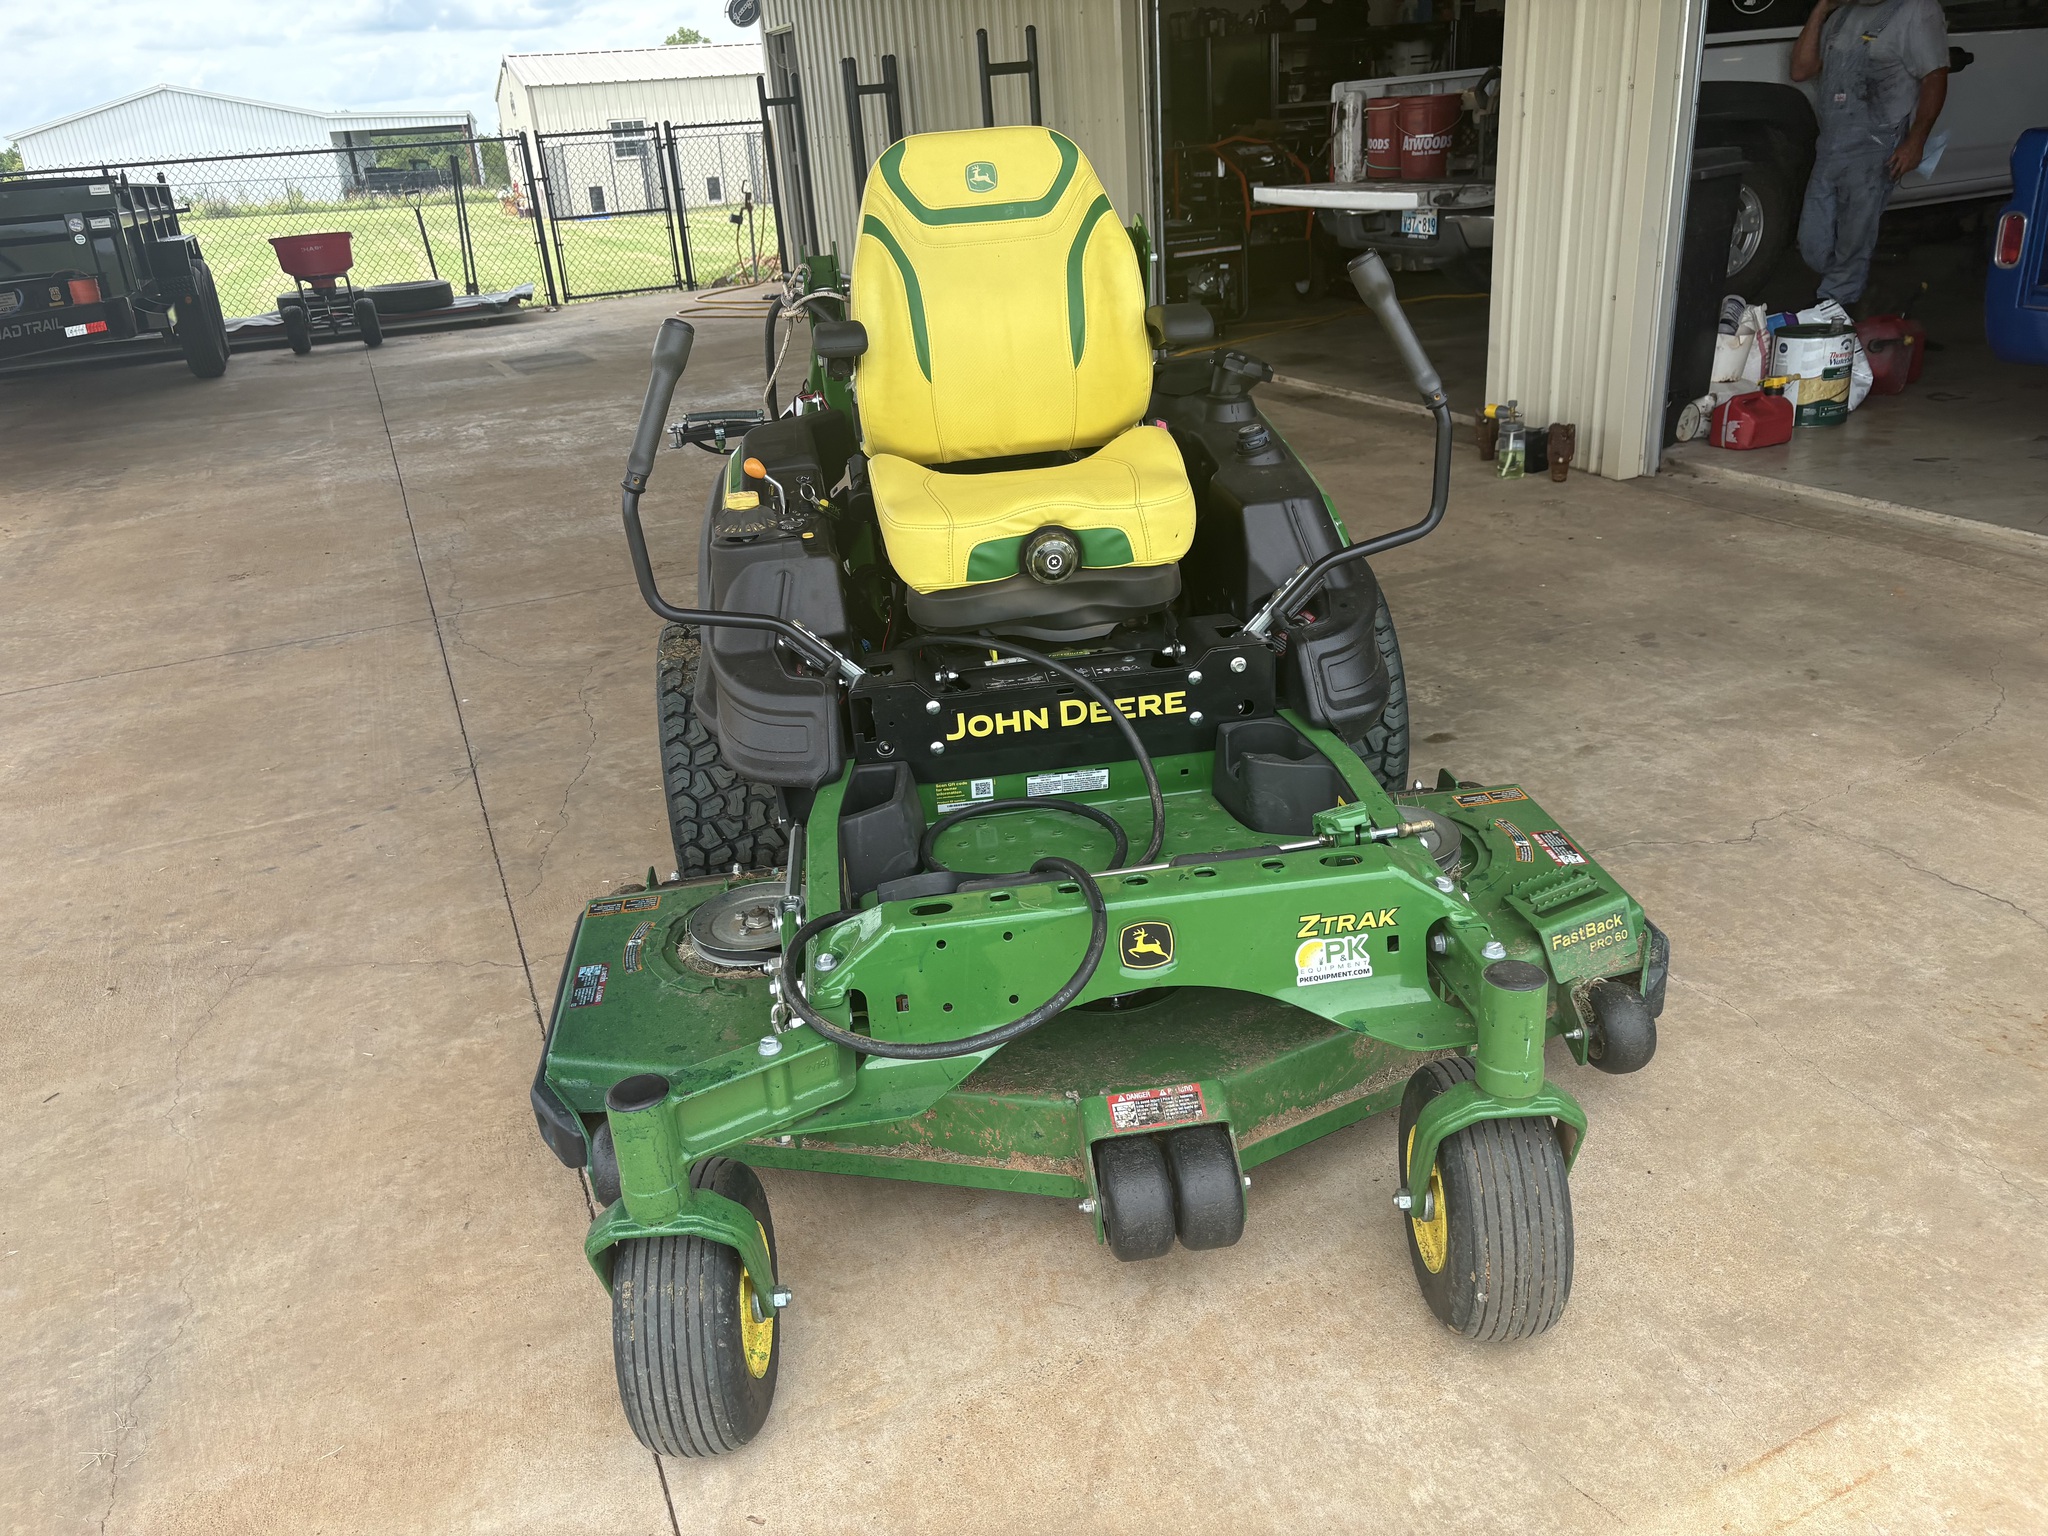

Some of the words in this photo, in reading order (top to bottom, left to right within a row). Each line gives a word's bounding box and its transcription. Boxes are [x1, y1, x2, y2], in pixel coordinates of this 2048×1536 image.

[1402, 135, 1453, 151] ATWOODS
[0, 324, 22, 340] AD
[23, 318, 64, 335] TRAIL
[946, 707, 1049, 741] JOHN
[1059, 691, 1187, 727] DEERE
[1297, 907, 1400, 938] ZTRAK
[1552, 913, 1623, 951] FastBack
[1589, 935, 1613, 952] PRO
[1614, 929, 1628, 942] 60
[1299, 968, 1371, 983] PKEQUIPMENT.COM
[1300, 960, 1368, 974] EQUIPMENT
[1125, 1091, 1151, 1101] DANGER
[1167, 1084, 1194, 1096] PIGRO
